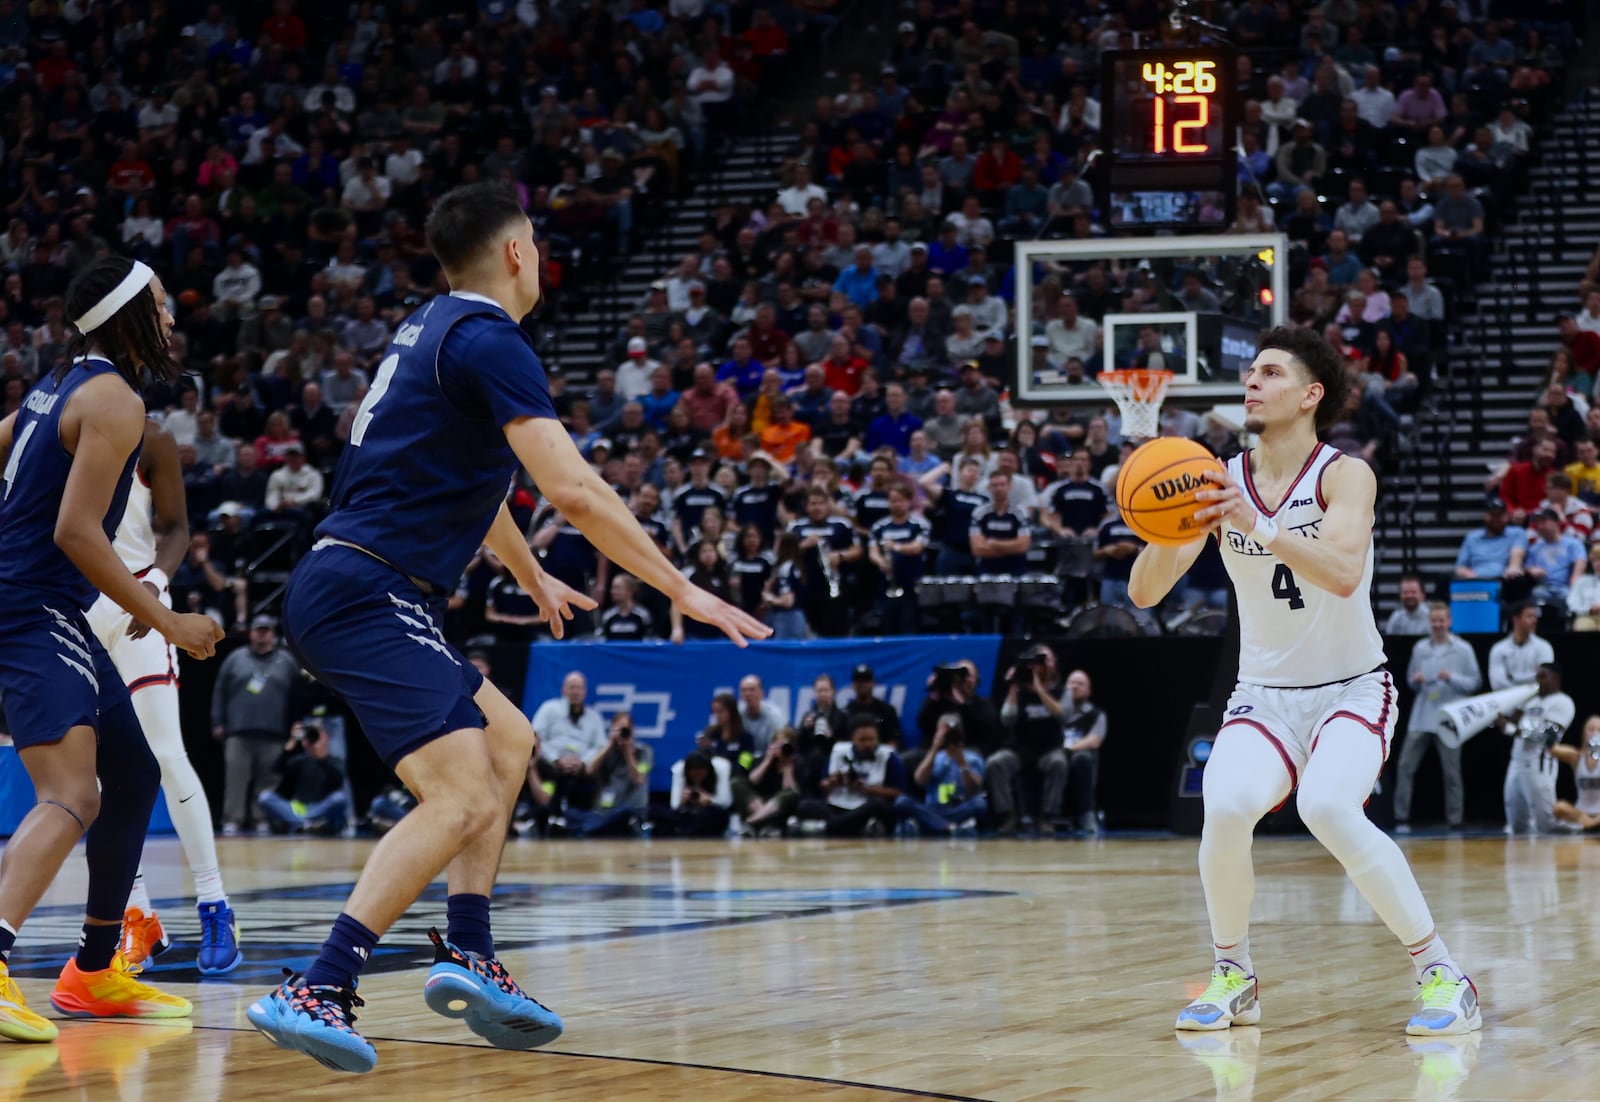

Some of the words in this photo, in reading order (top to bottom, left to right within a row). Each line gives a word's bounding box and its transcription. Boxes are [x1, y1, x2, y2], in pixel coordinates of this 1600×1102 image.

[1142, 61, 1216, 94] 4:26
[1154, 95, 1209, 154] 12
[350, 352, 400, 448] 2
[1151, 472, 1214, 501] Wilso
[1270, 563, 1305, 611] 4
